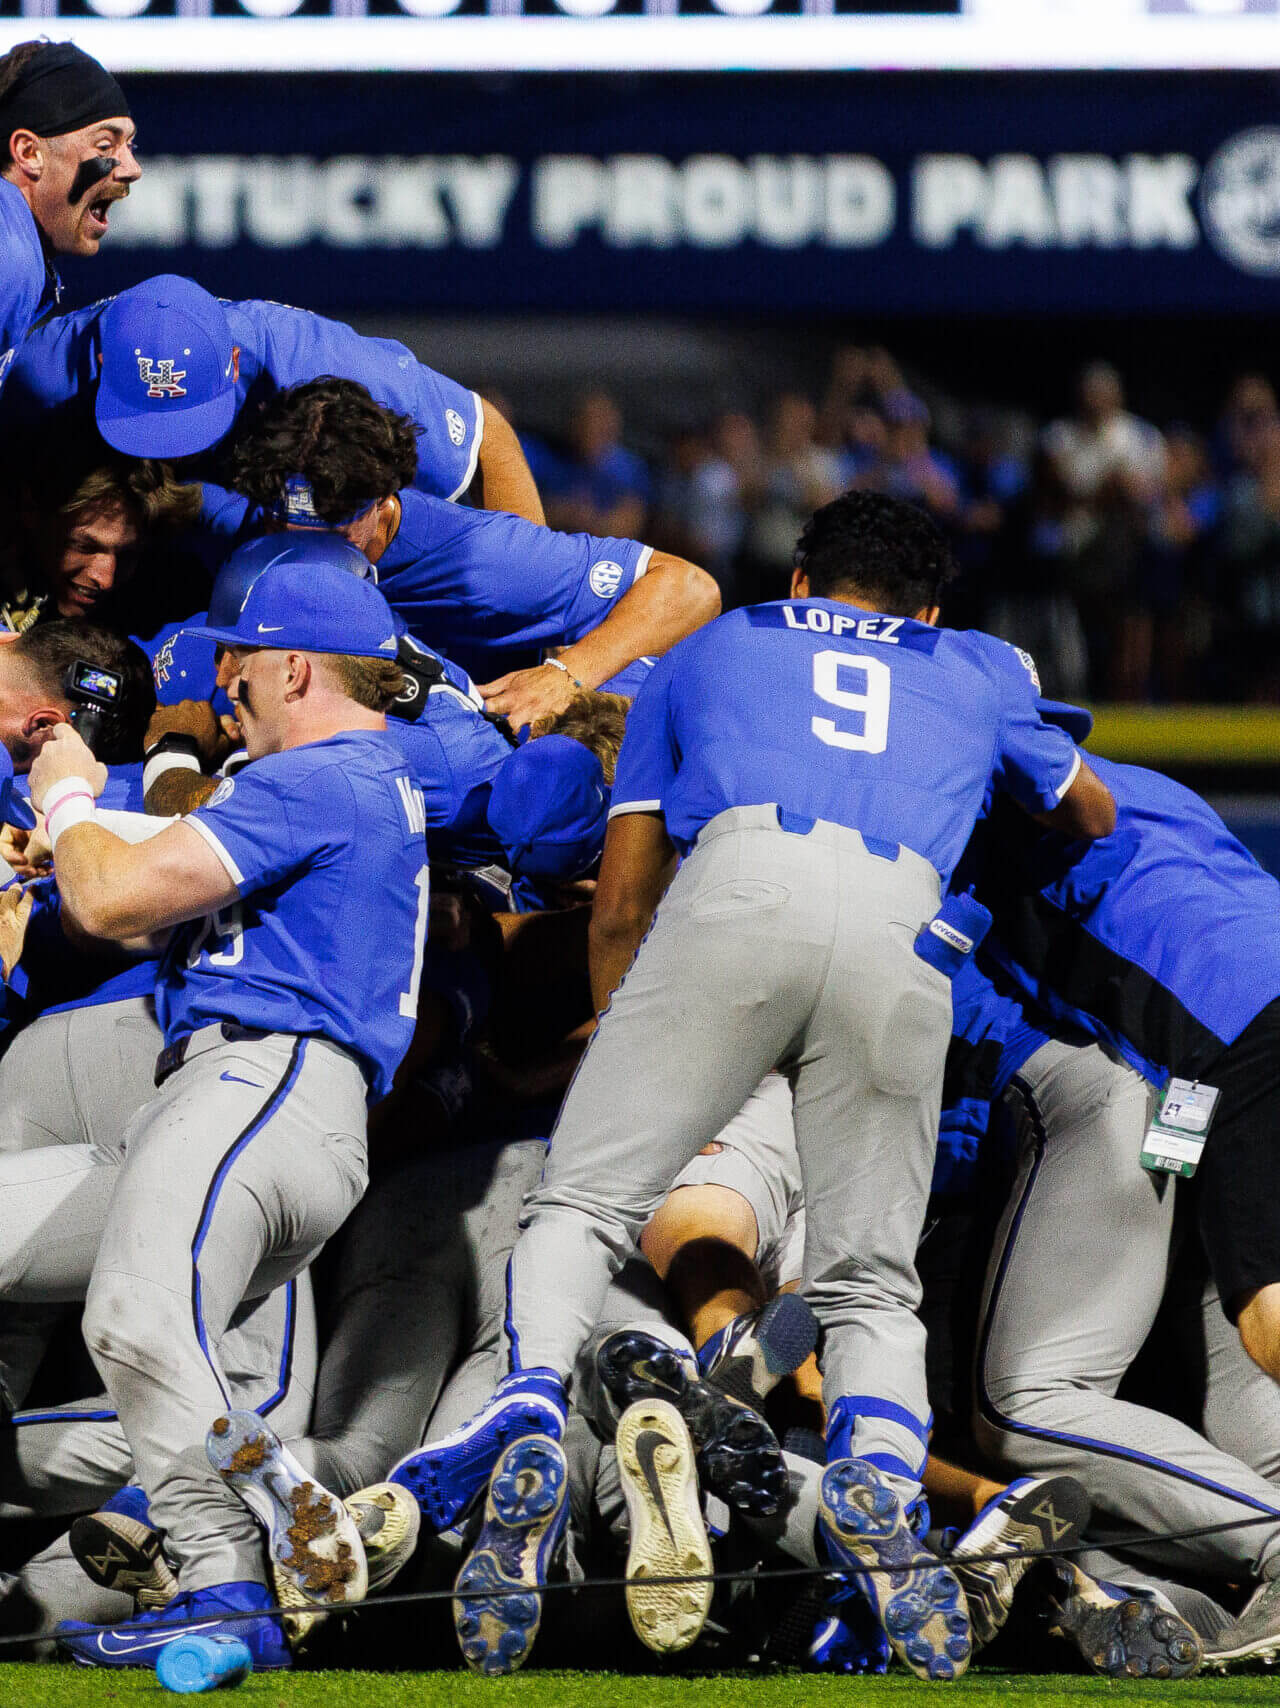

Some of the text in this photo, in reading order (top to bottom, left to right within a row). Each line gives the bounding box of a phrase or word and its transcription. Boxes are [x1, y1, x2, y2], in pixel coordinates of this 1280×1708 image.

[105, 154, 1200, 249] NTUCKY PROUD PARK
[782, 605, 906, 645] LOPEZ
[811, 649, 891, 755] 9
